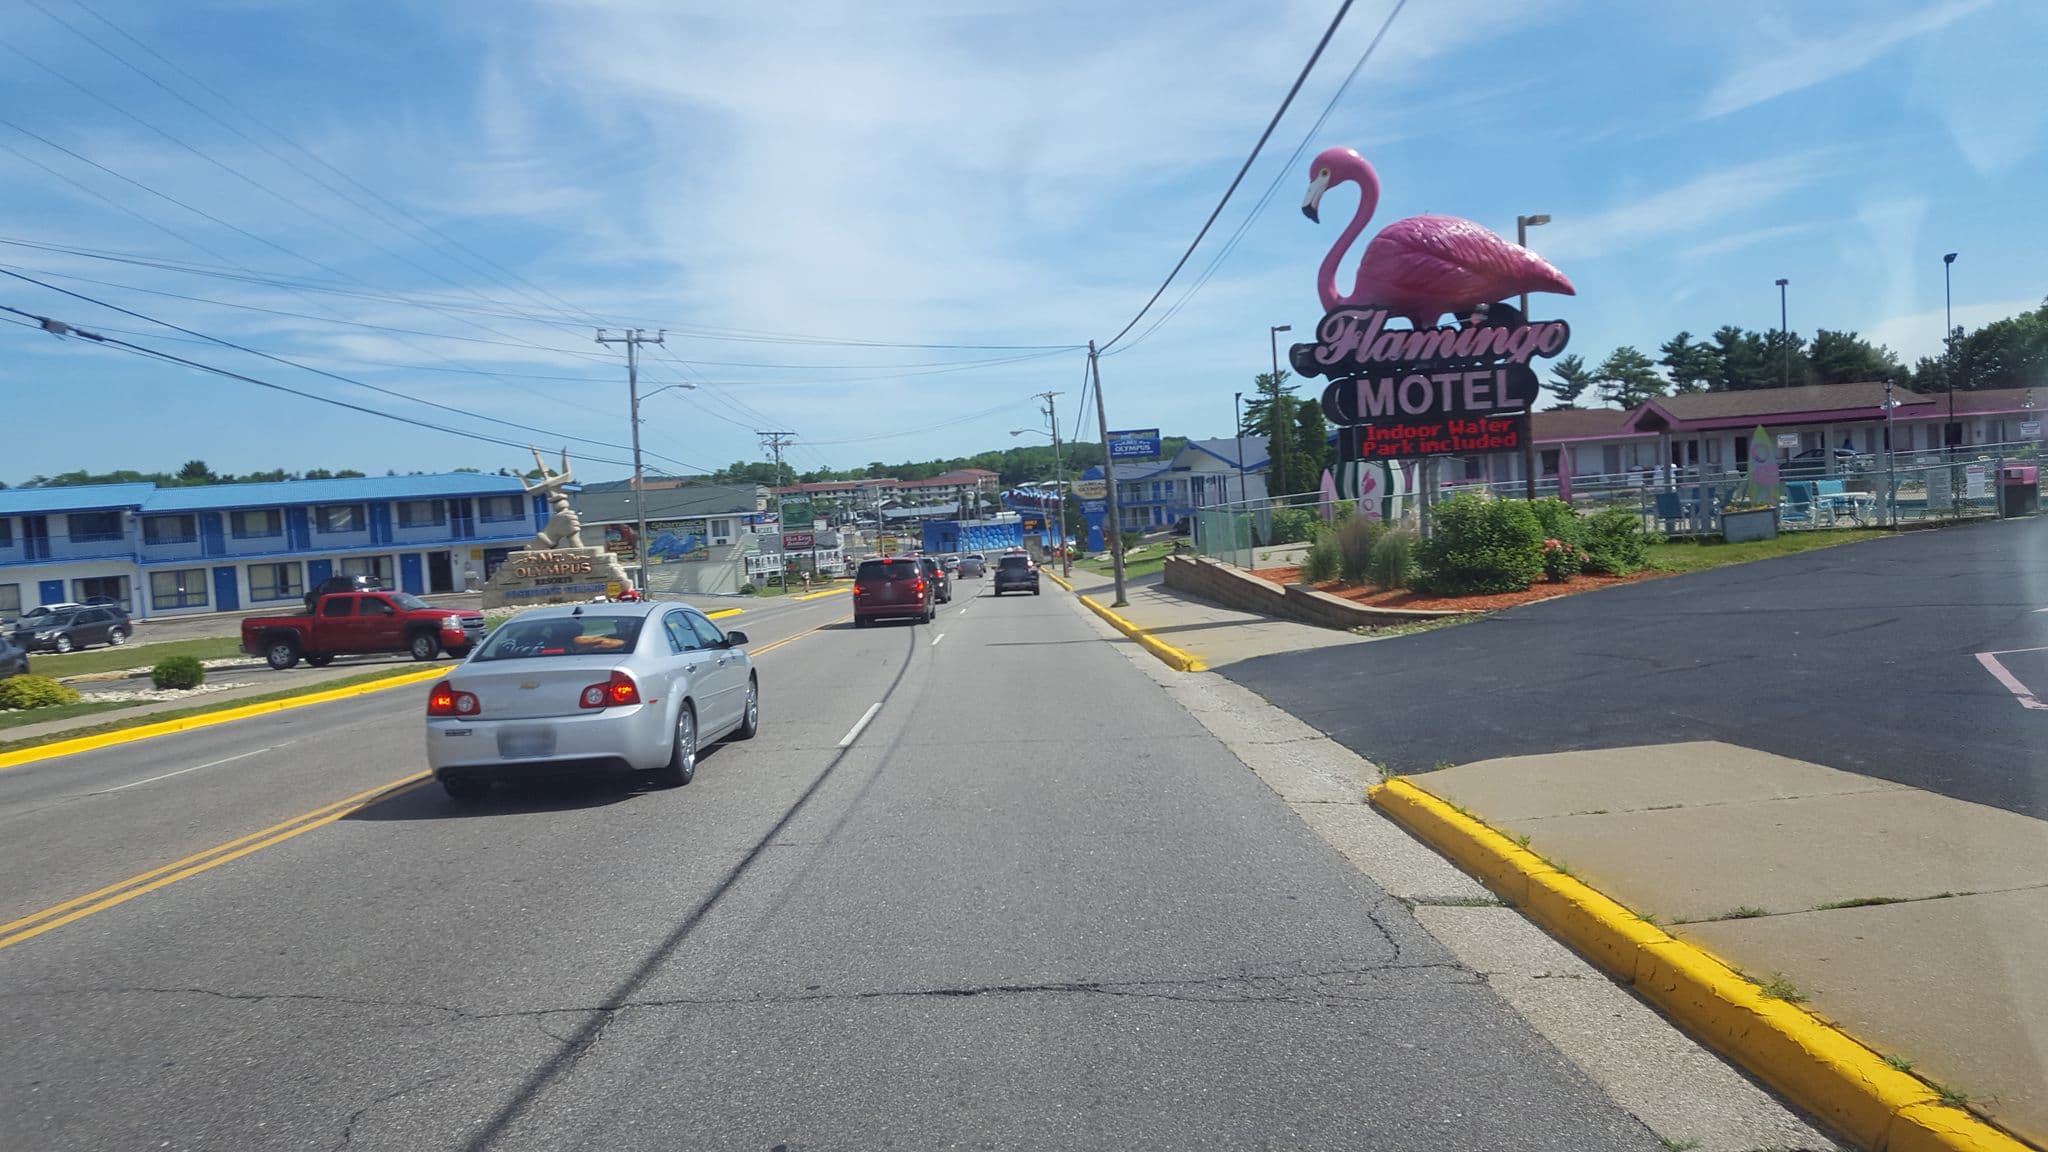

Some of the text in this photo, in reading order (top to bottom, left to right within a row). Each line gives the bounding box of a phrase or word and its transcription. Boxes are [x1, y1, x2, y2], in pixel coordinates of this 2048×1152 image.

[1314, 307, 1567, 365] Flamingo
[1355, 369, 1525, 418] MOTEL
[1366, 418, 1515, 442] Indoor Water
[1361, 431, 1517, 458] Park included
[515, 562, 593, 578] OLYMPUS
